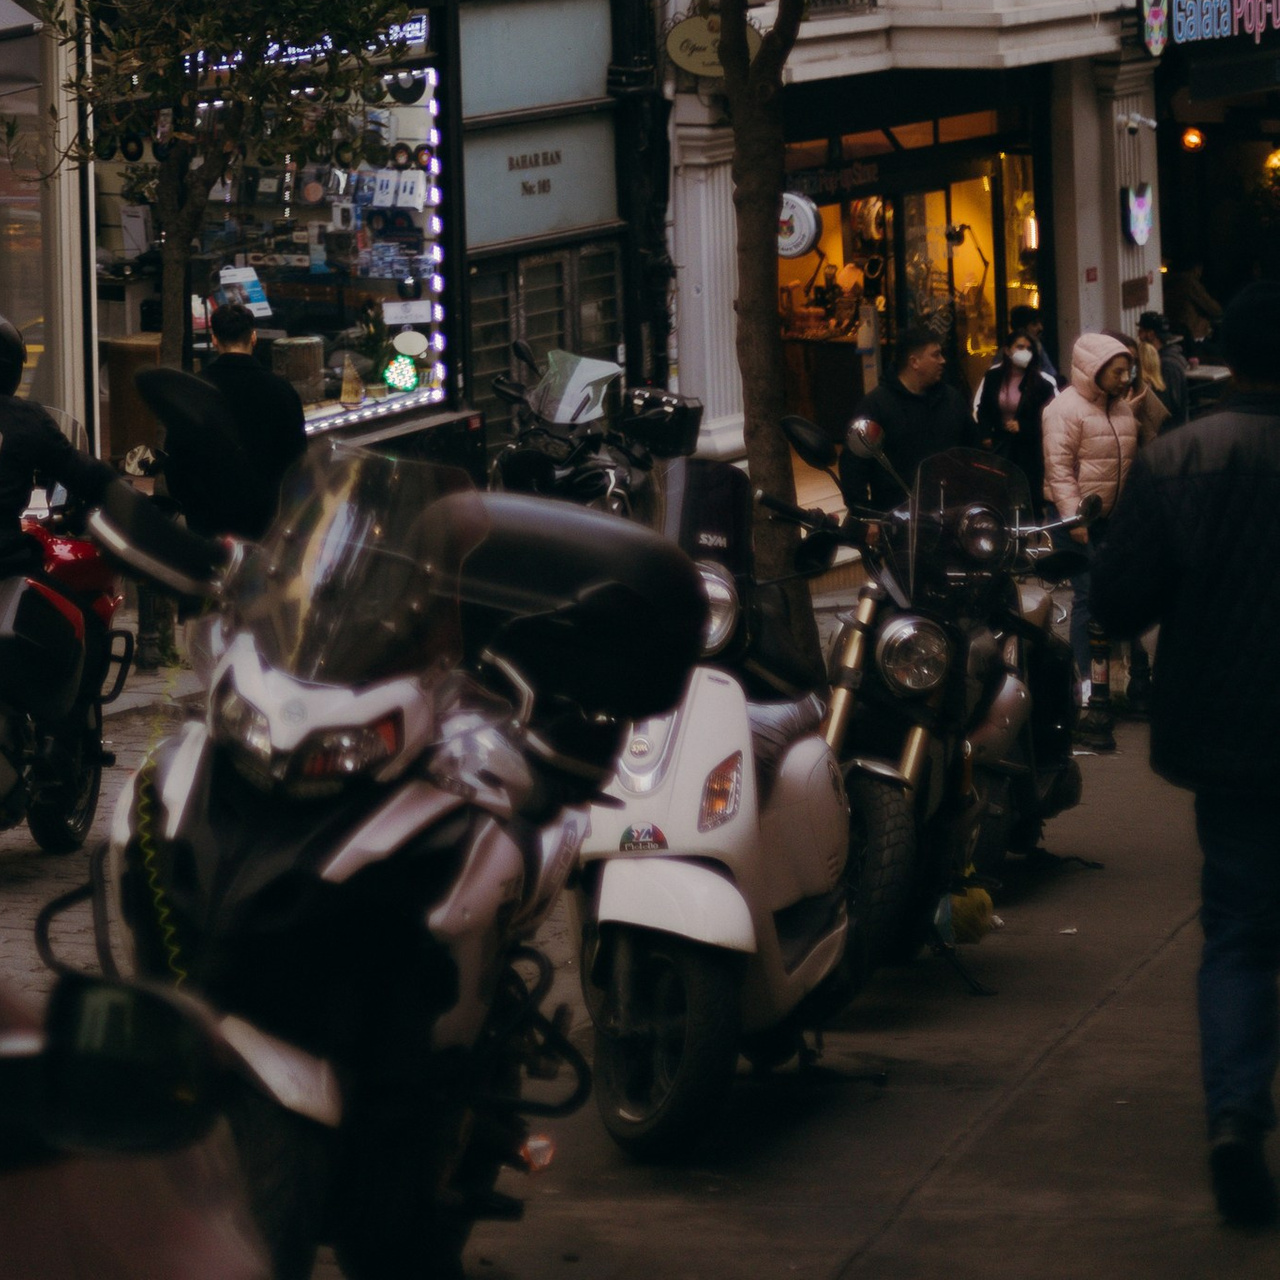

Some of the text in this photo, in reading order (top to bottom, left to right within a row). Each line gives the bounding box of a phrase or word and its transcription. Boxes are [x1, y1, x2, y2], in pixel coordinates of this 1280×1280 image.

[508, 150, 562, 172] BAHAR HAN
[698, 532, 727, 548] SYM
[631, 743, 648, 754] SYM
[629, 828, 654, 841] SYM
